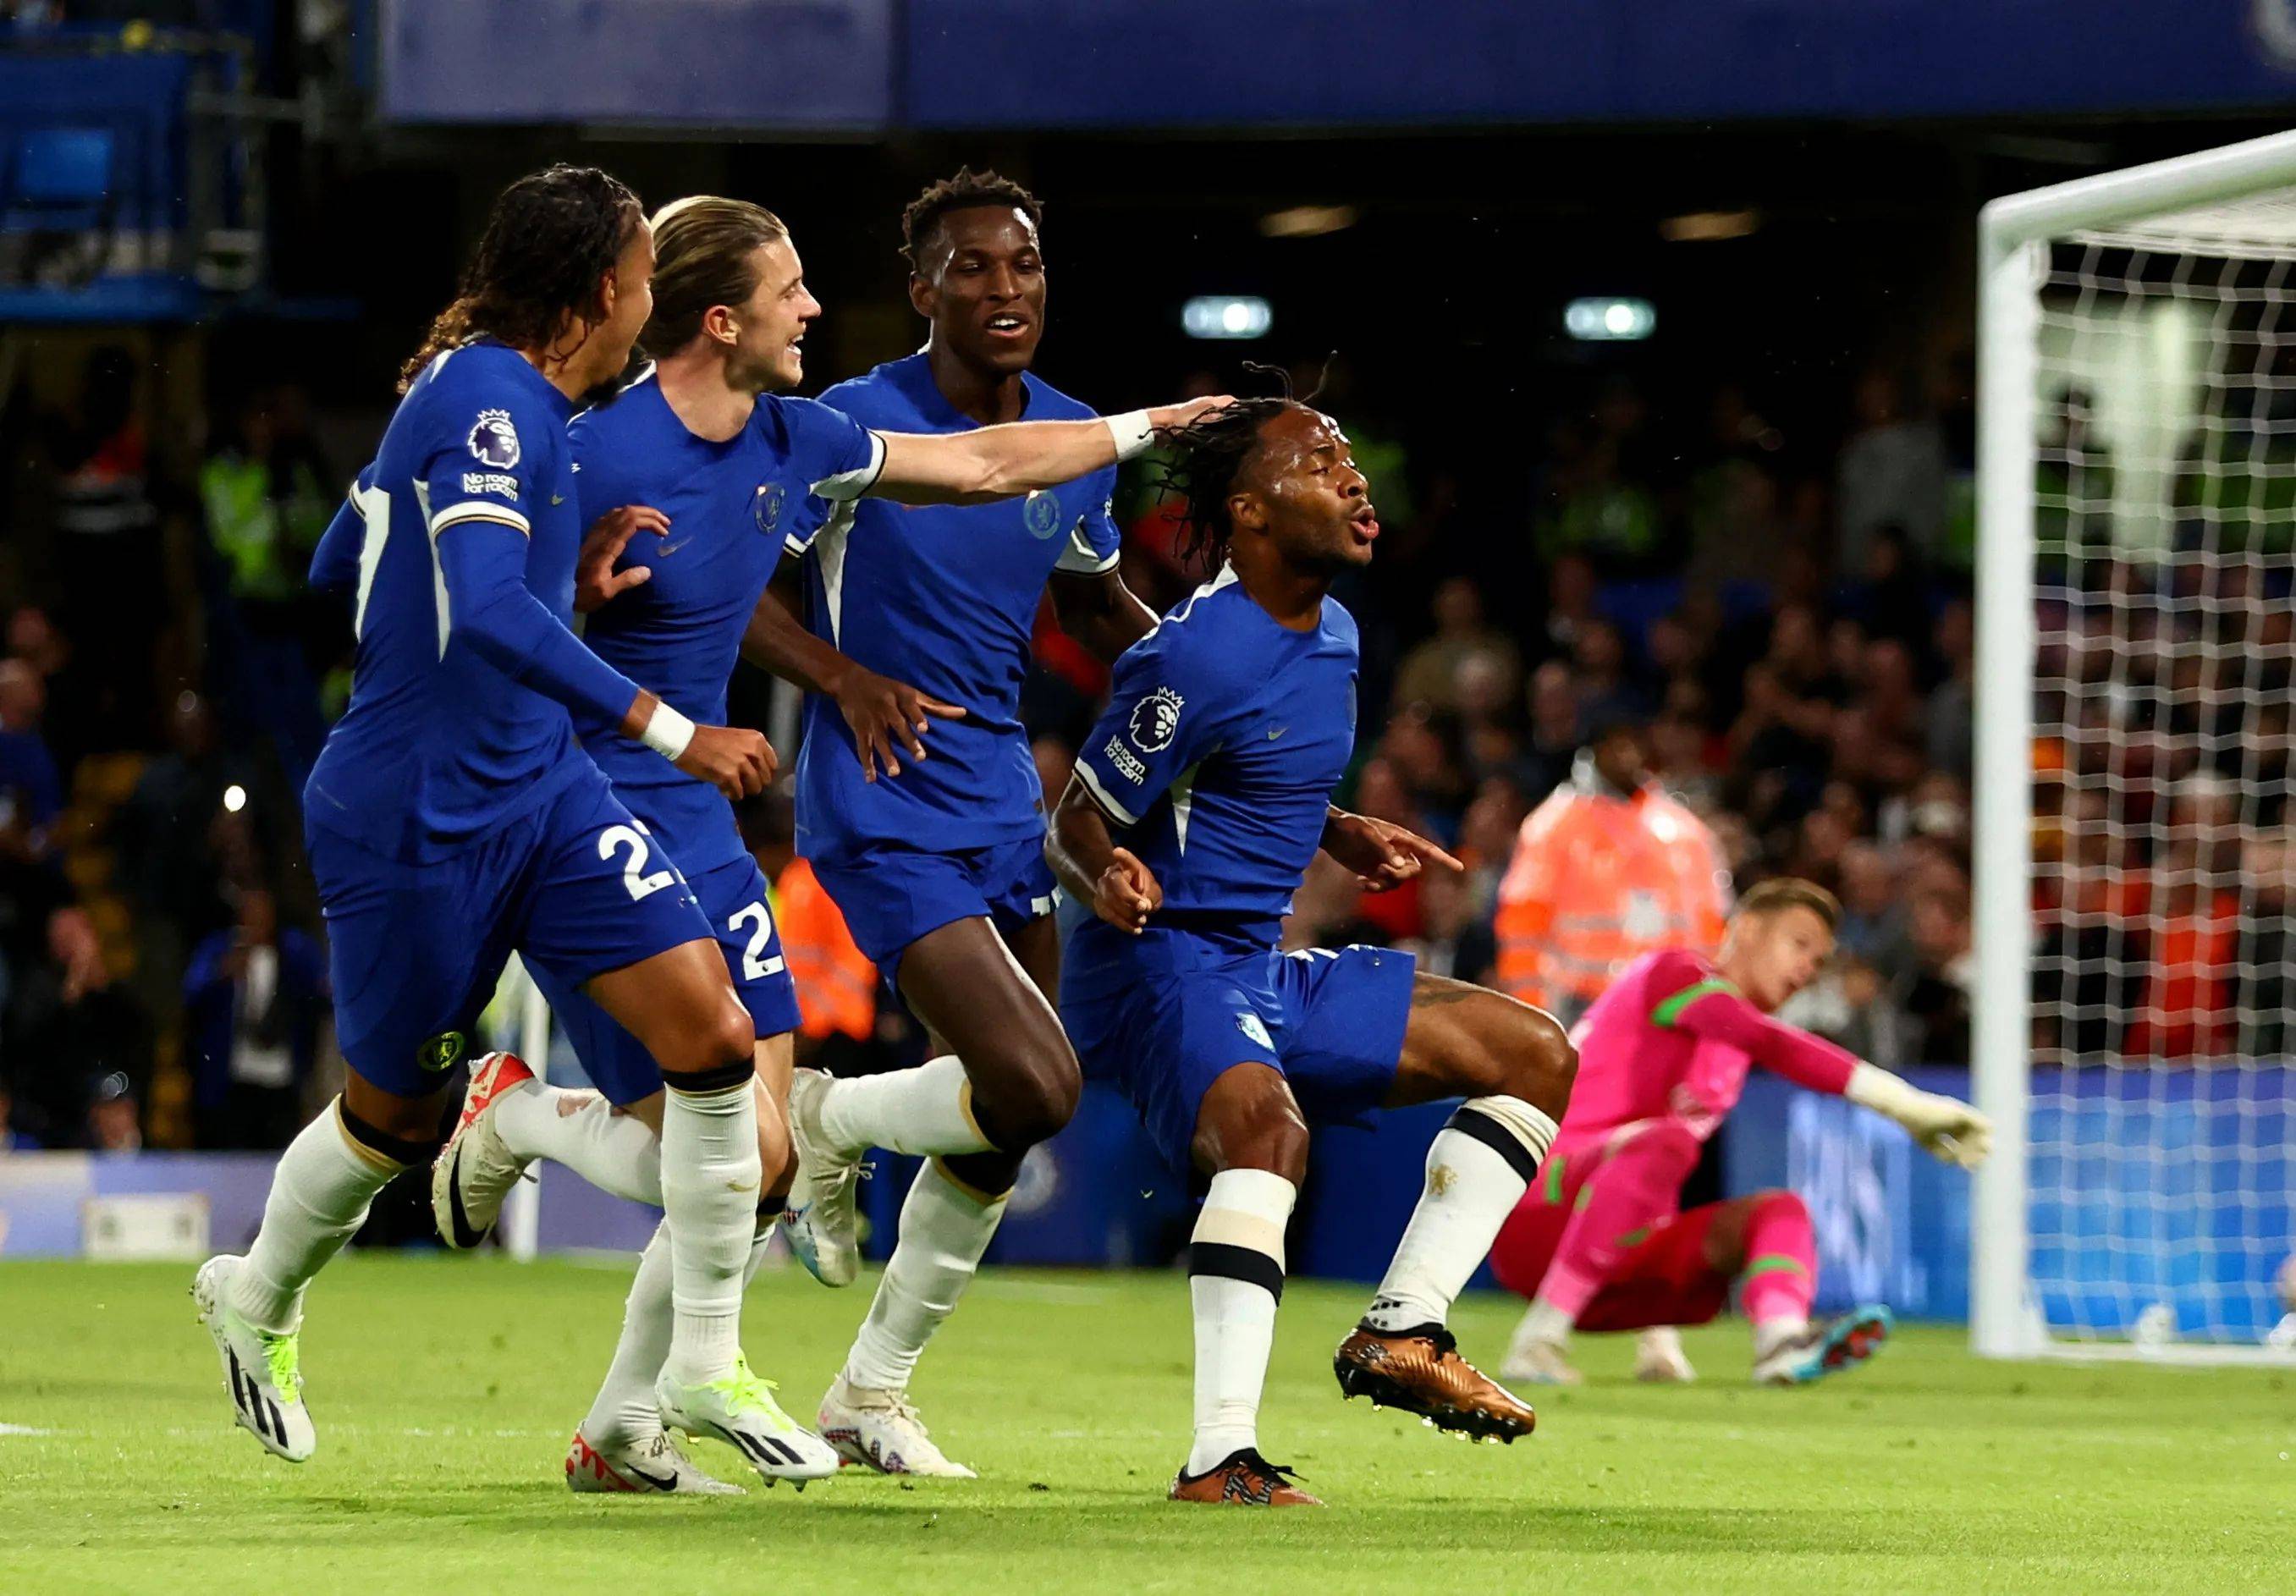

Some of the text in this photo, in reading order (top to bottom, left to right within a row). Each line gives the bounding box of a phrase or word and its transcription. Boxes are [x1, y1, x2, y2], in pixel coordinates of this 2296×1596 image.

[463, 472, 518, 490] No room
[1109, 735, 1146, 775] No room
[1113, 756, 1144, 786] racism
[598, 819, 686, 901] 2
[729, 901, 785, 981] 2
